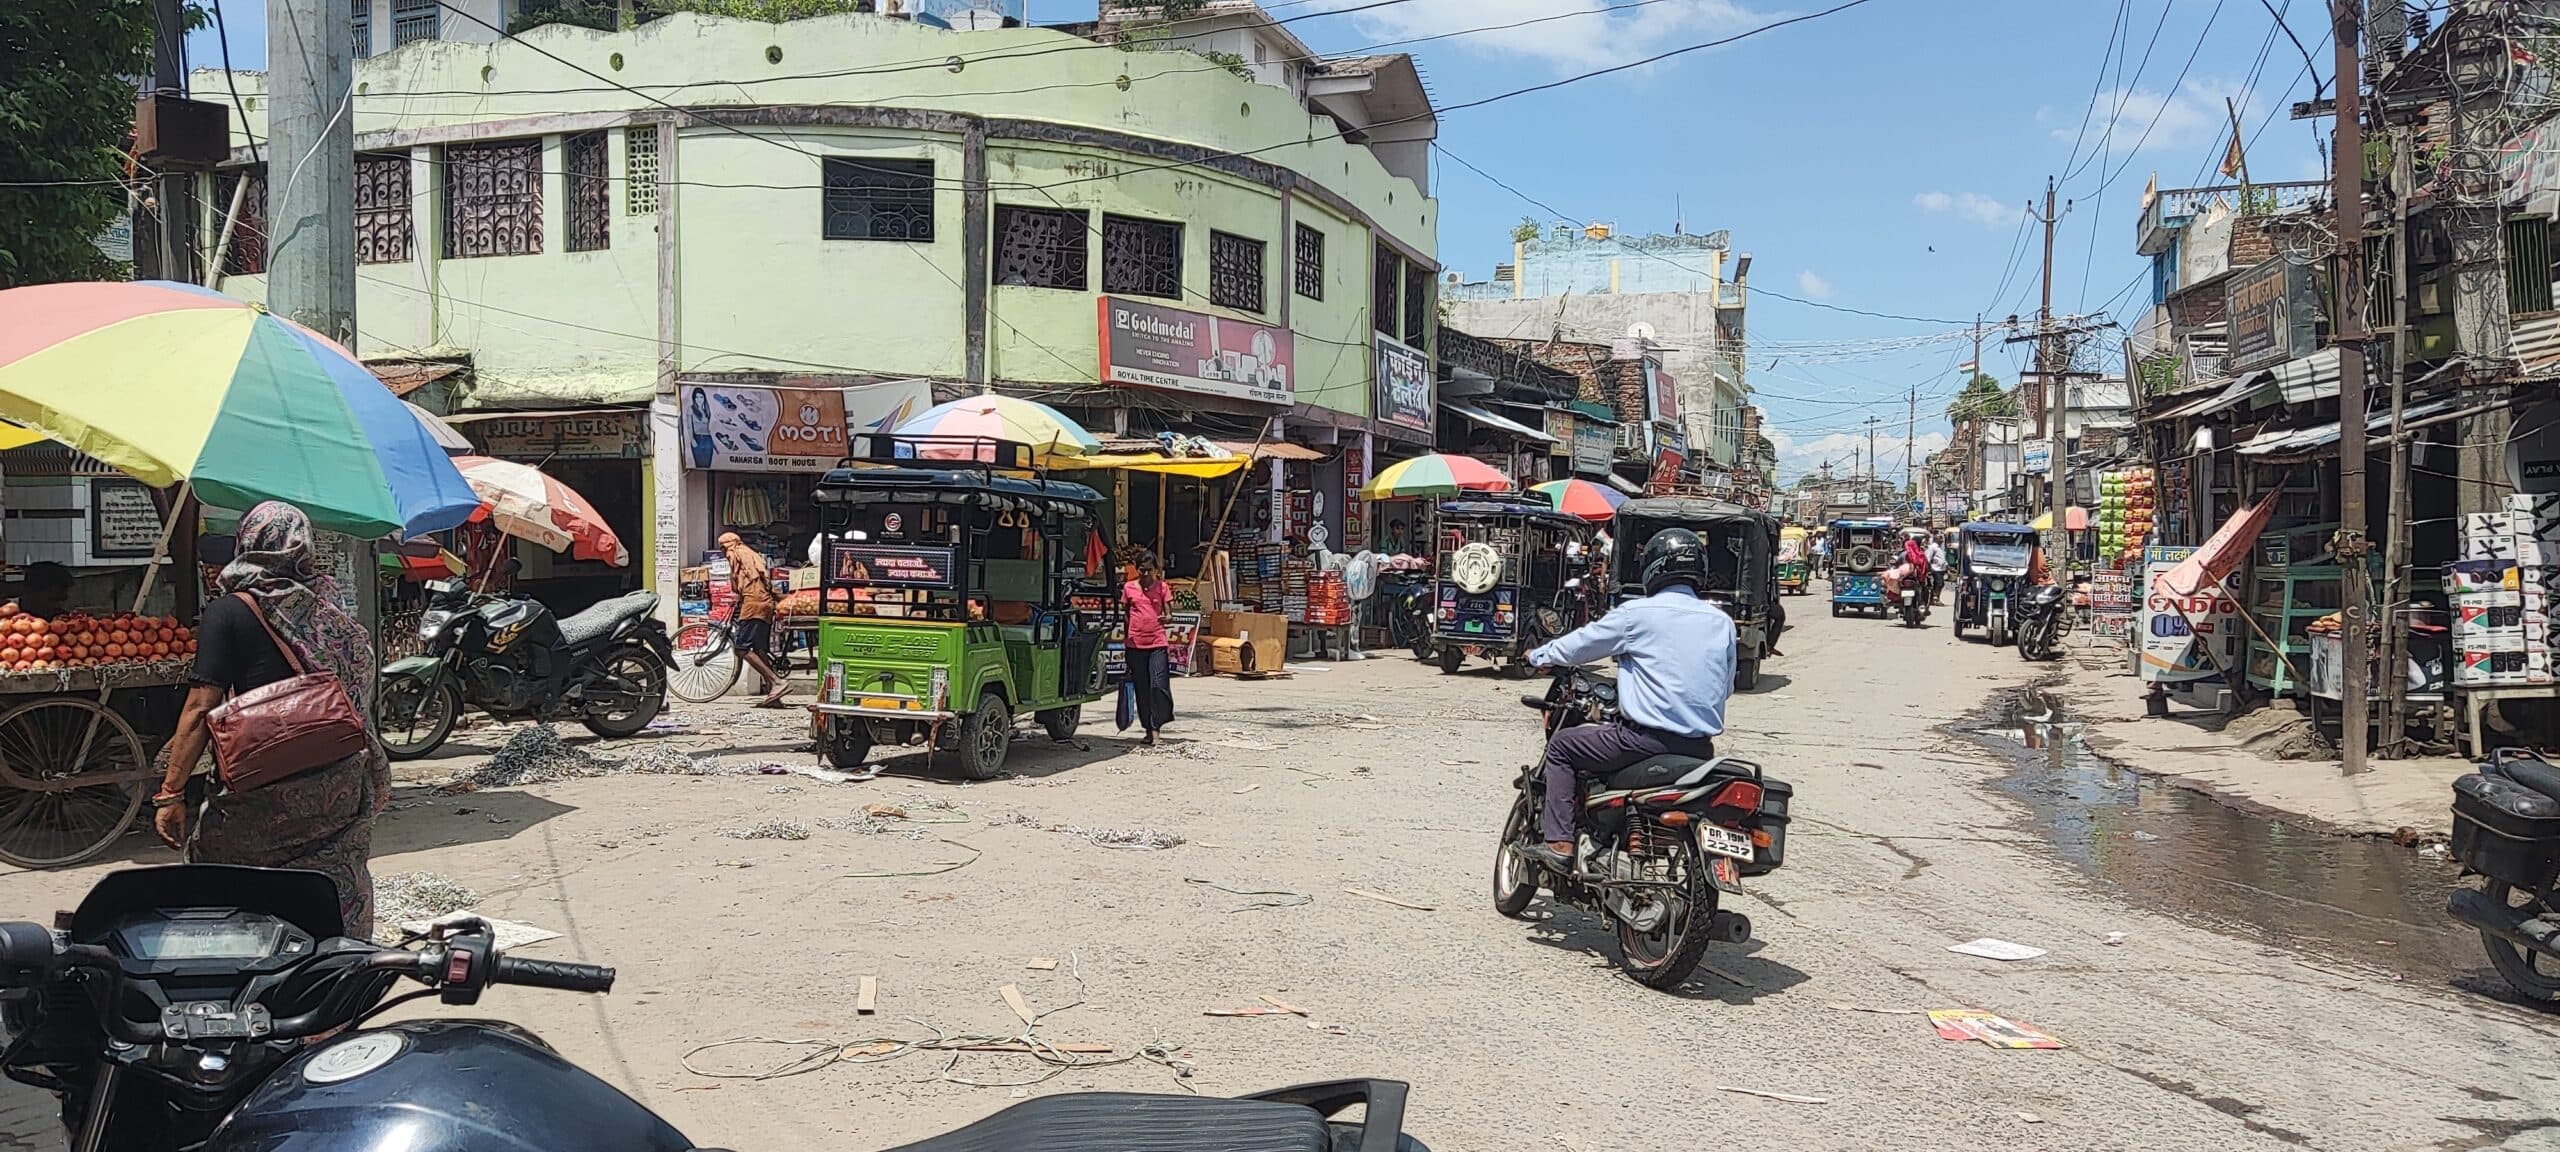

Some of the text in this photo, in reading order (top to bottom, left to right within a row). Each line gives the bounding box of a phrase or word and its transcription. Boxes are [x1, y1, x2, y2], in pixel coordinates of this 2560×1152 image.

[1131, 313, 1194, 340] Goldmedal
[1152, 334, 1160, 342] TO
[1117, 370, 1179, 386] ROYAL TIME CENTRE
[768, 457, 788, 466] BOOT
[791, 458, 817, 467] HOUSE
[1709, 827, 1722, 839] BR
[1706, 839, 1751, 856] 2237
